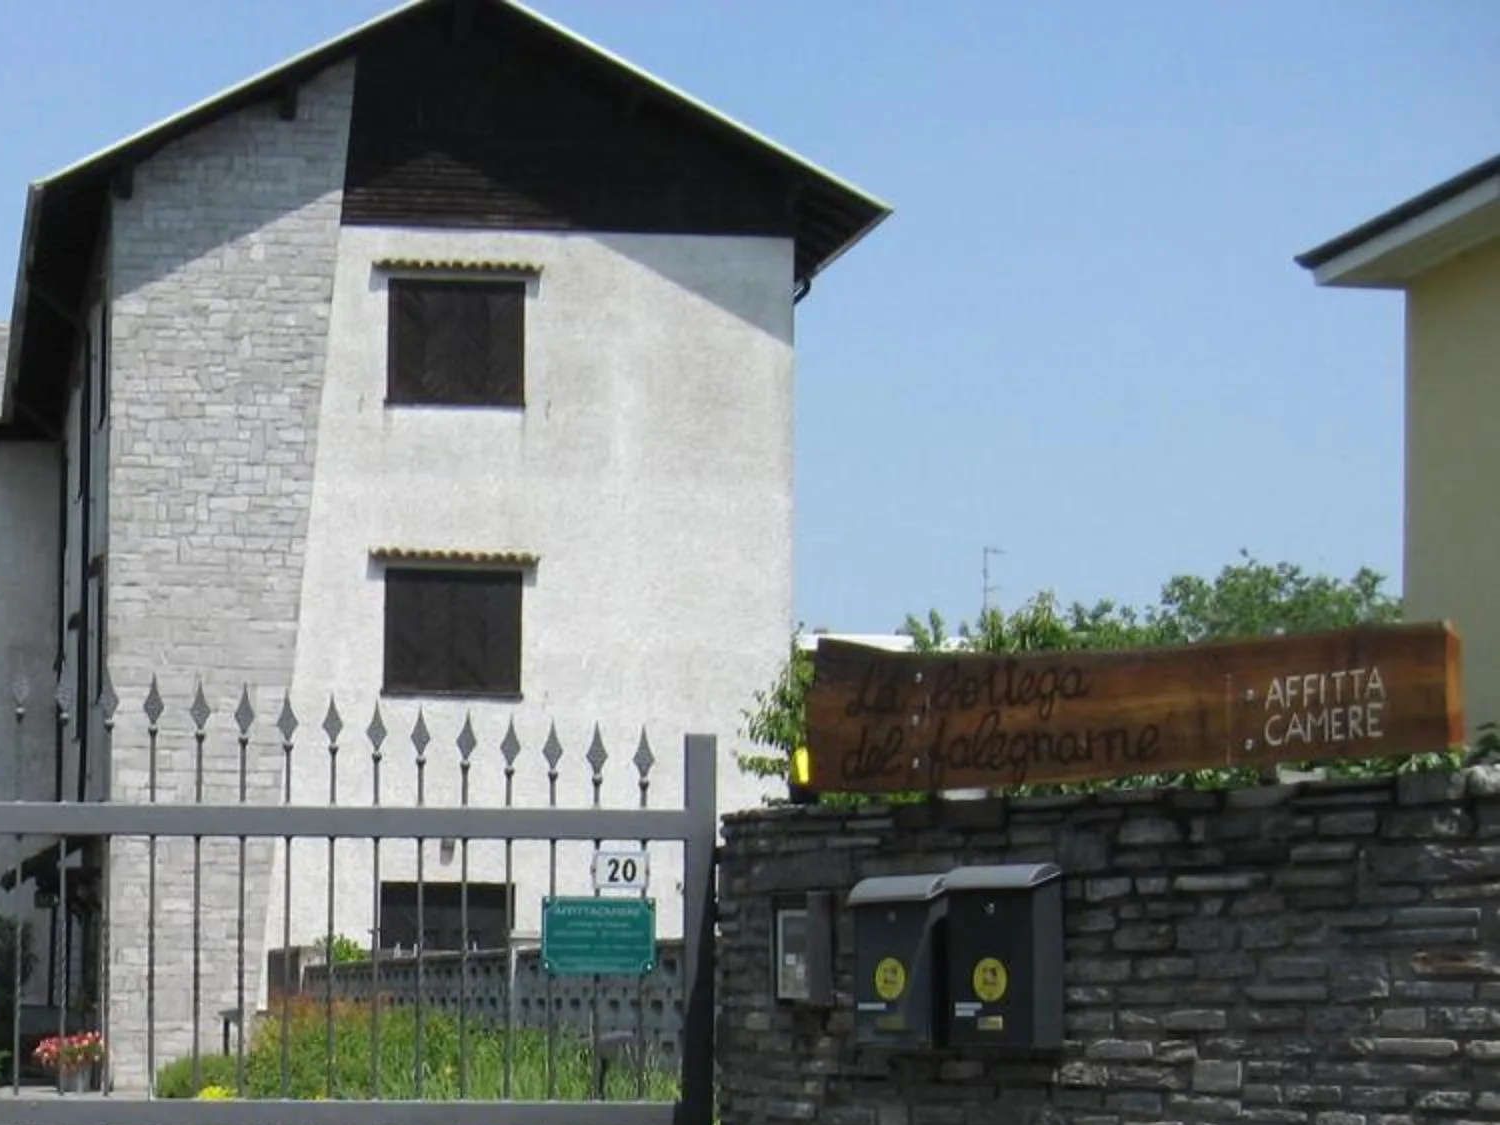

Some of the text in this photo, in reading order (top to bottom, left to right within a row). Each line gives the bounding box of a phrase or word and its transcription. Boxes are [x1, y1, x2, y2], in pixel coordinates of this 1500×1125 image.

[1265, 666, 1387, 711] AFFITTA
[1264, 702, 1384, 746] CAMERE
[607, 858, 637, 882] 20
